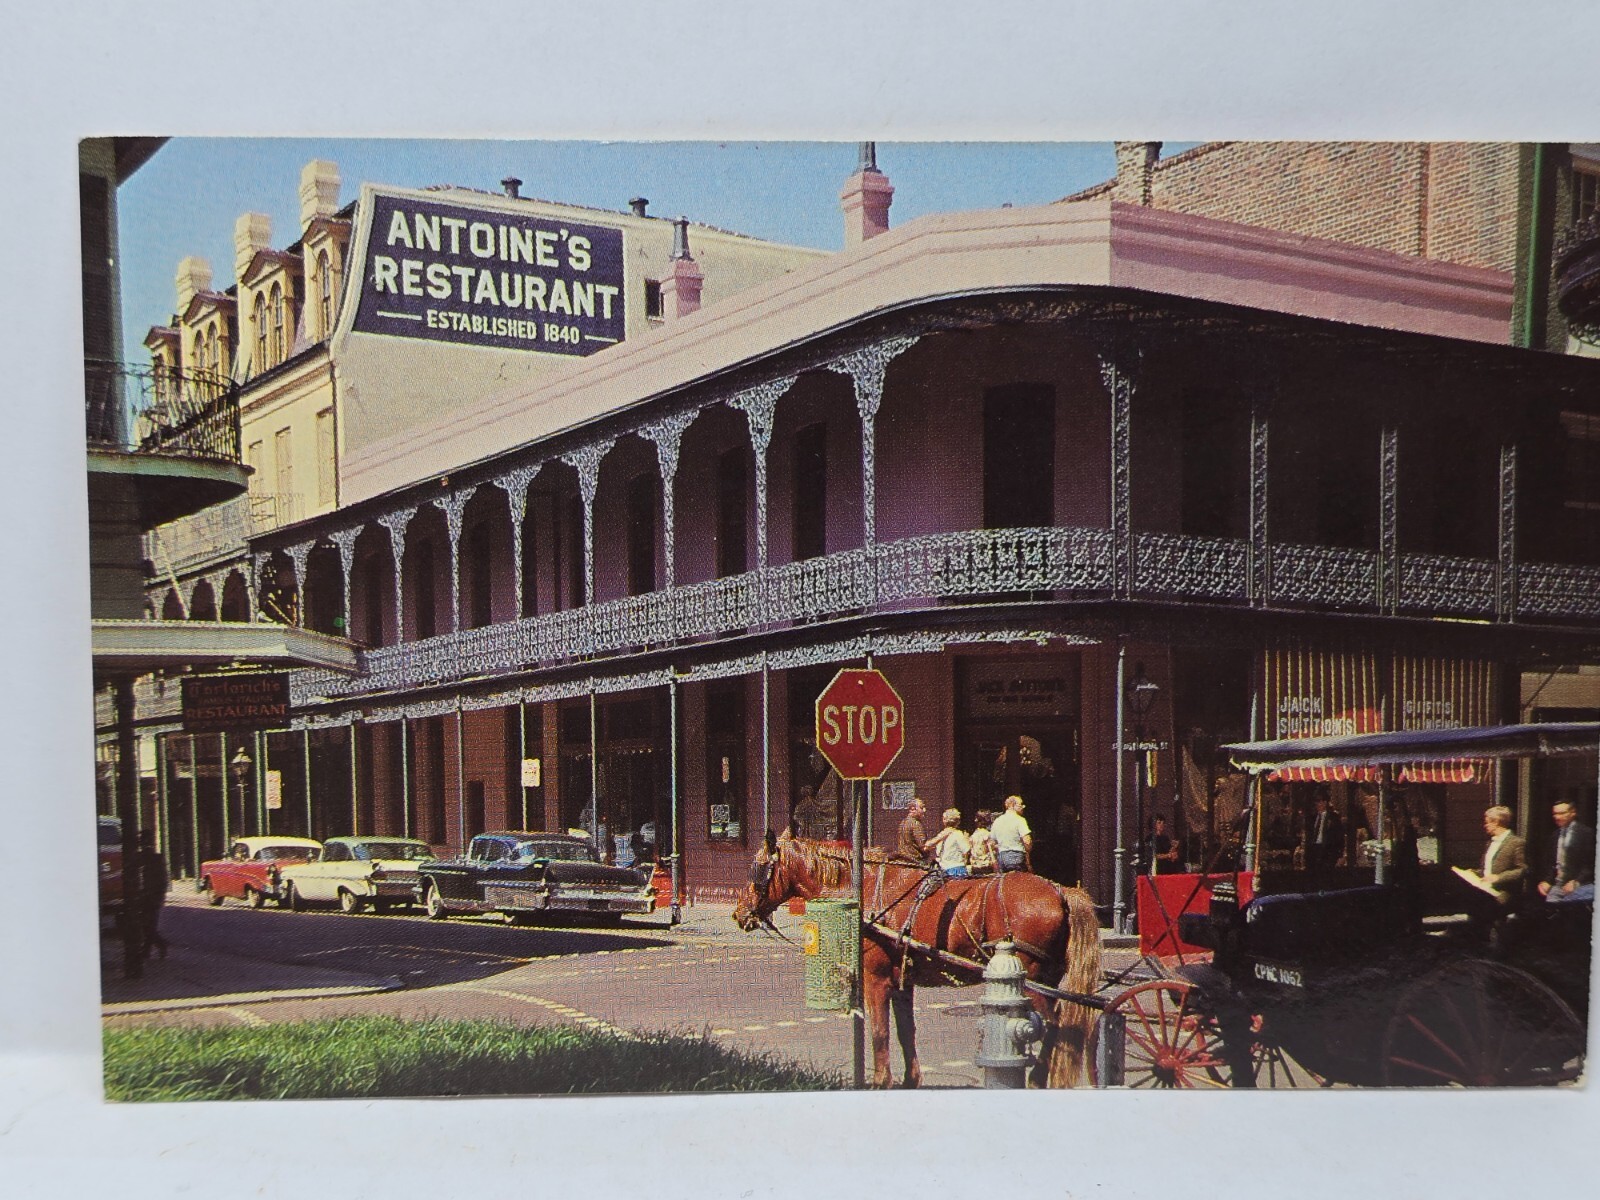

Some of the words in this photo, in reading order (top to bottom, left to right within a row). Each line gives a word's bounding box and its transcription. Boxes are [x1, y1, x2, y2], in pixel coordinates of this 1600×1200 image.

[387, 210, 592, 272] ANTOINE'S
[374, 255, 619, 319] RESTAURANT
[427, 310, 538, 340] ESTABLISHED
[544, 323, 580, 344] 1840
[186, 703, 287, 720] RESTAURANT
[1280, 696, 1322, 713] JACK
[1405, 700, 1452, 715] GIFTS
[823, 704, 899, 745] STOP
[1279, 717, 1354, 735] SUTTONS
